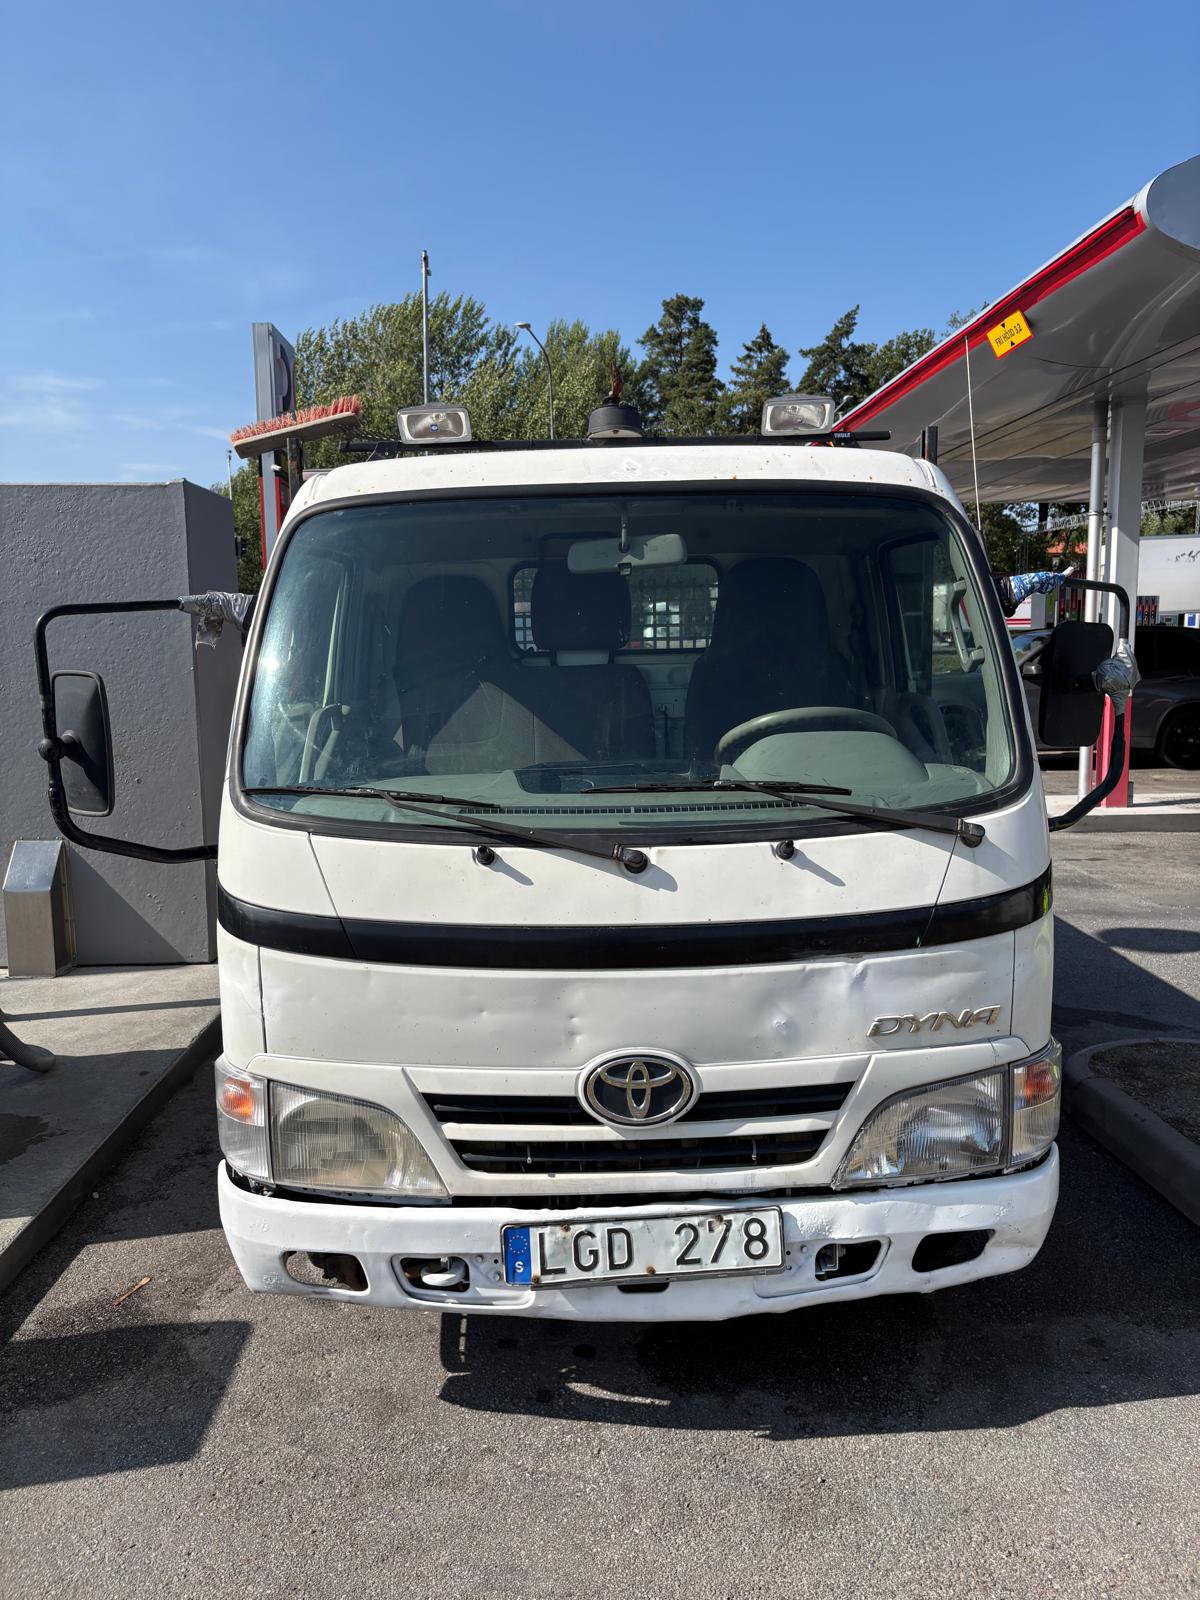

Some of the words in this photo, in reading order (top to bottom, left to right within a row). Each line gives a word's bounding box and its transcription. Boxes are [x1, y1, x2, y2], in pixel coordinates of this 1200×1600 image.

[866, 1005, 1001, 1037] DYNA
[538, 1227, 633, 1276] LGD
[675, 1217, 769, 1266] 278
[514, 1260, 524, 1273] S
